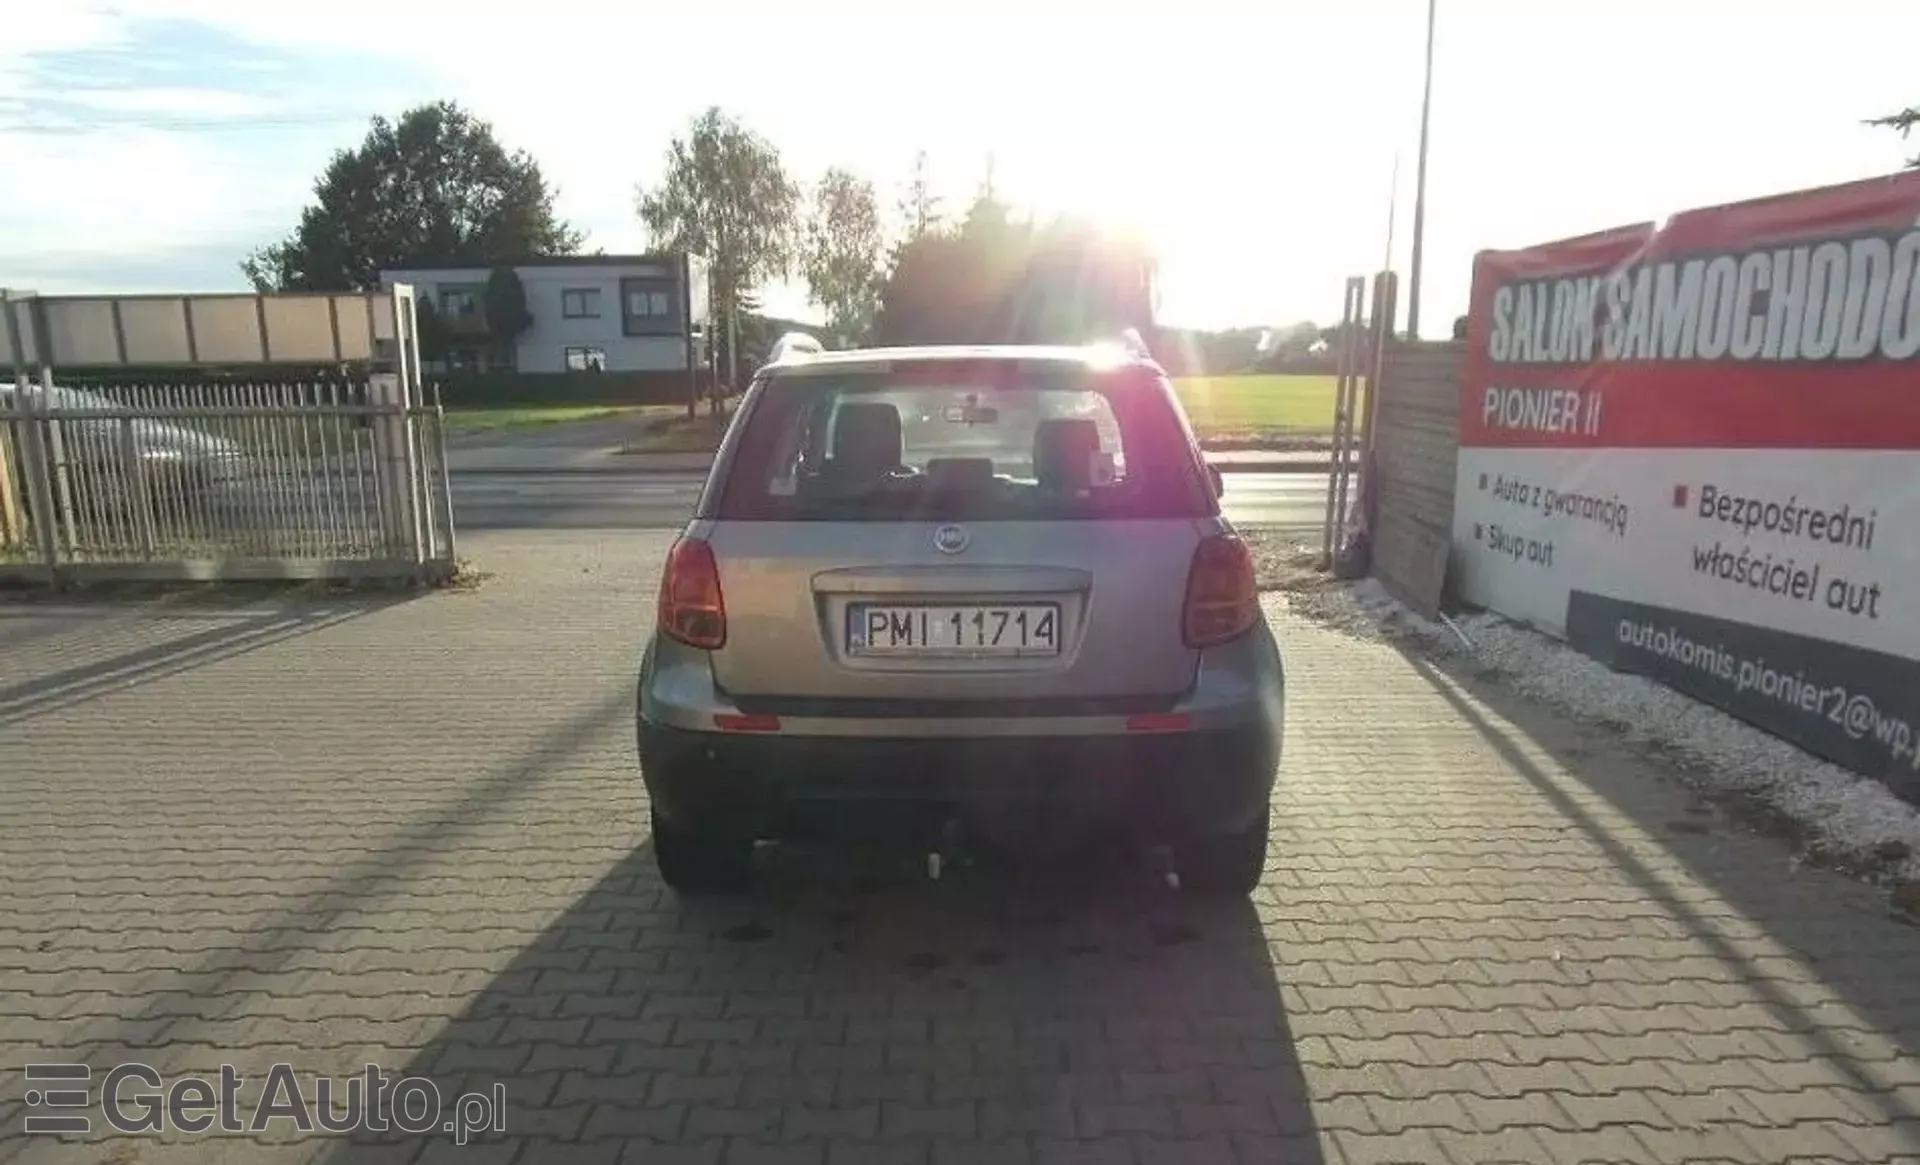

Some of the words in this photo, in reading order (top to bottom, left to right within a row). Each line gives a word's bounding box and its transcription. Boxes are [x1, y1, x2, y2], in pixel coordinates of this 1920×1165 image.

[1489, 276, 1600, 363] SALON
[1484, 386, 1581, 434] PIONIER
[1584, 390, 1602, 437] II
[1532, 486, 1541, 507] z
[1544, 488, 1628, 536] gwarancją
[1699, 484, 1879, 550] Bezpośredni
[1488, 523, 1525, 563] Skup
[1526, 540, 1554, 568] aut
[1692, 543, 1821, 602] właściciel
[1826, 585, 1883, 620] aut
[868, 611, 929, 646] PMI
[950, 611, 1054, 646] 11714
